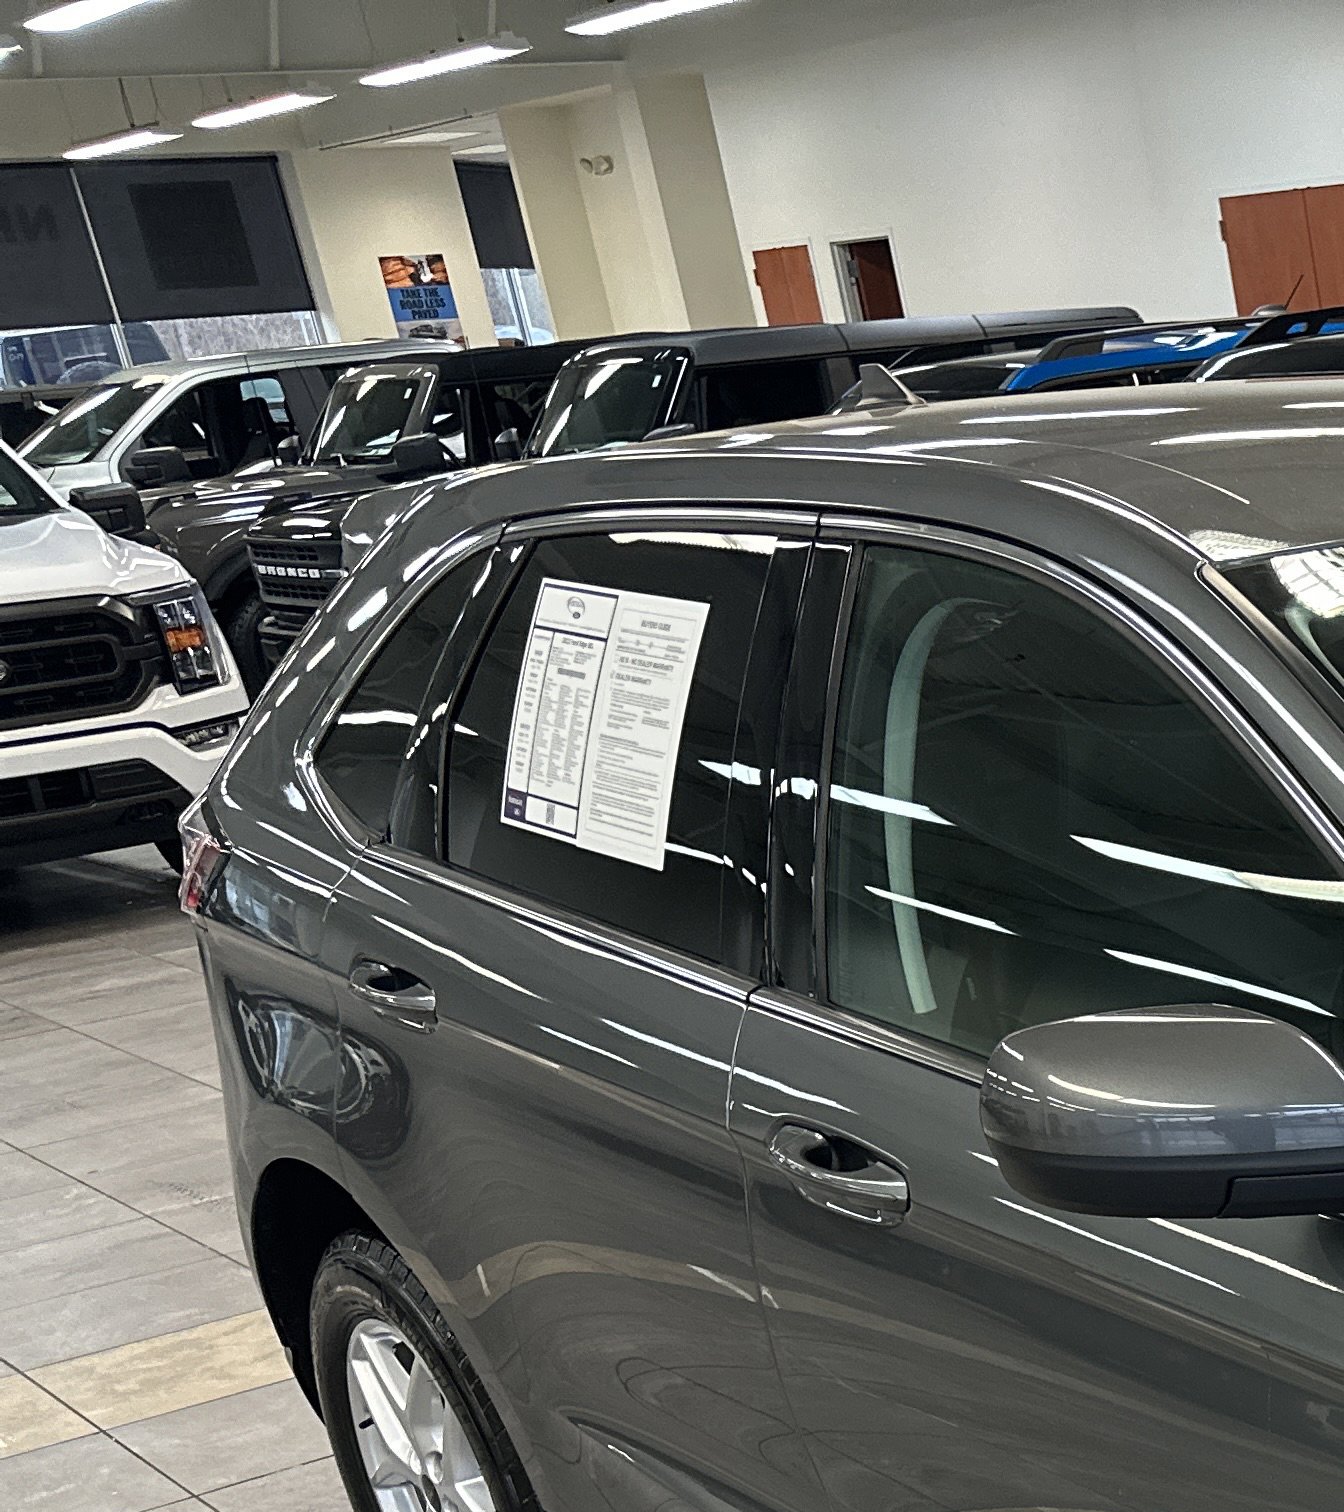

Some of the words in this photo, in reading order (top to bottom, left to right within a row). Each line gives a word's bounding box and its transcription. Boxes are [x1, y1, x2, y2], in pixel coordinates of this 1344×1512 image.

[400, 288, 422, 299] TAKE
[422, 287, 441, 298] THE
[400, 299, 424, 310] ROAD
[425, 297, 446, 309] LESS
[257, 564, 321, 579] BRONCO
